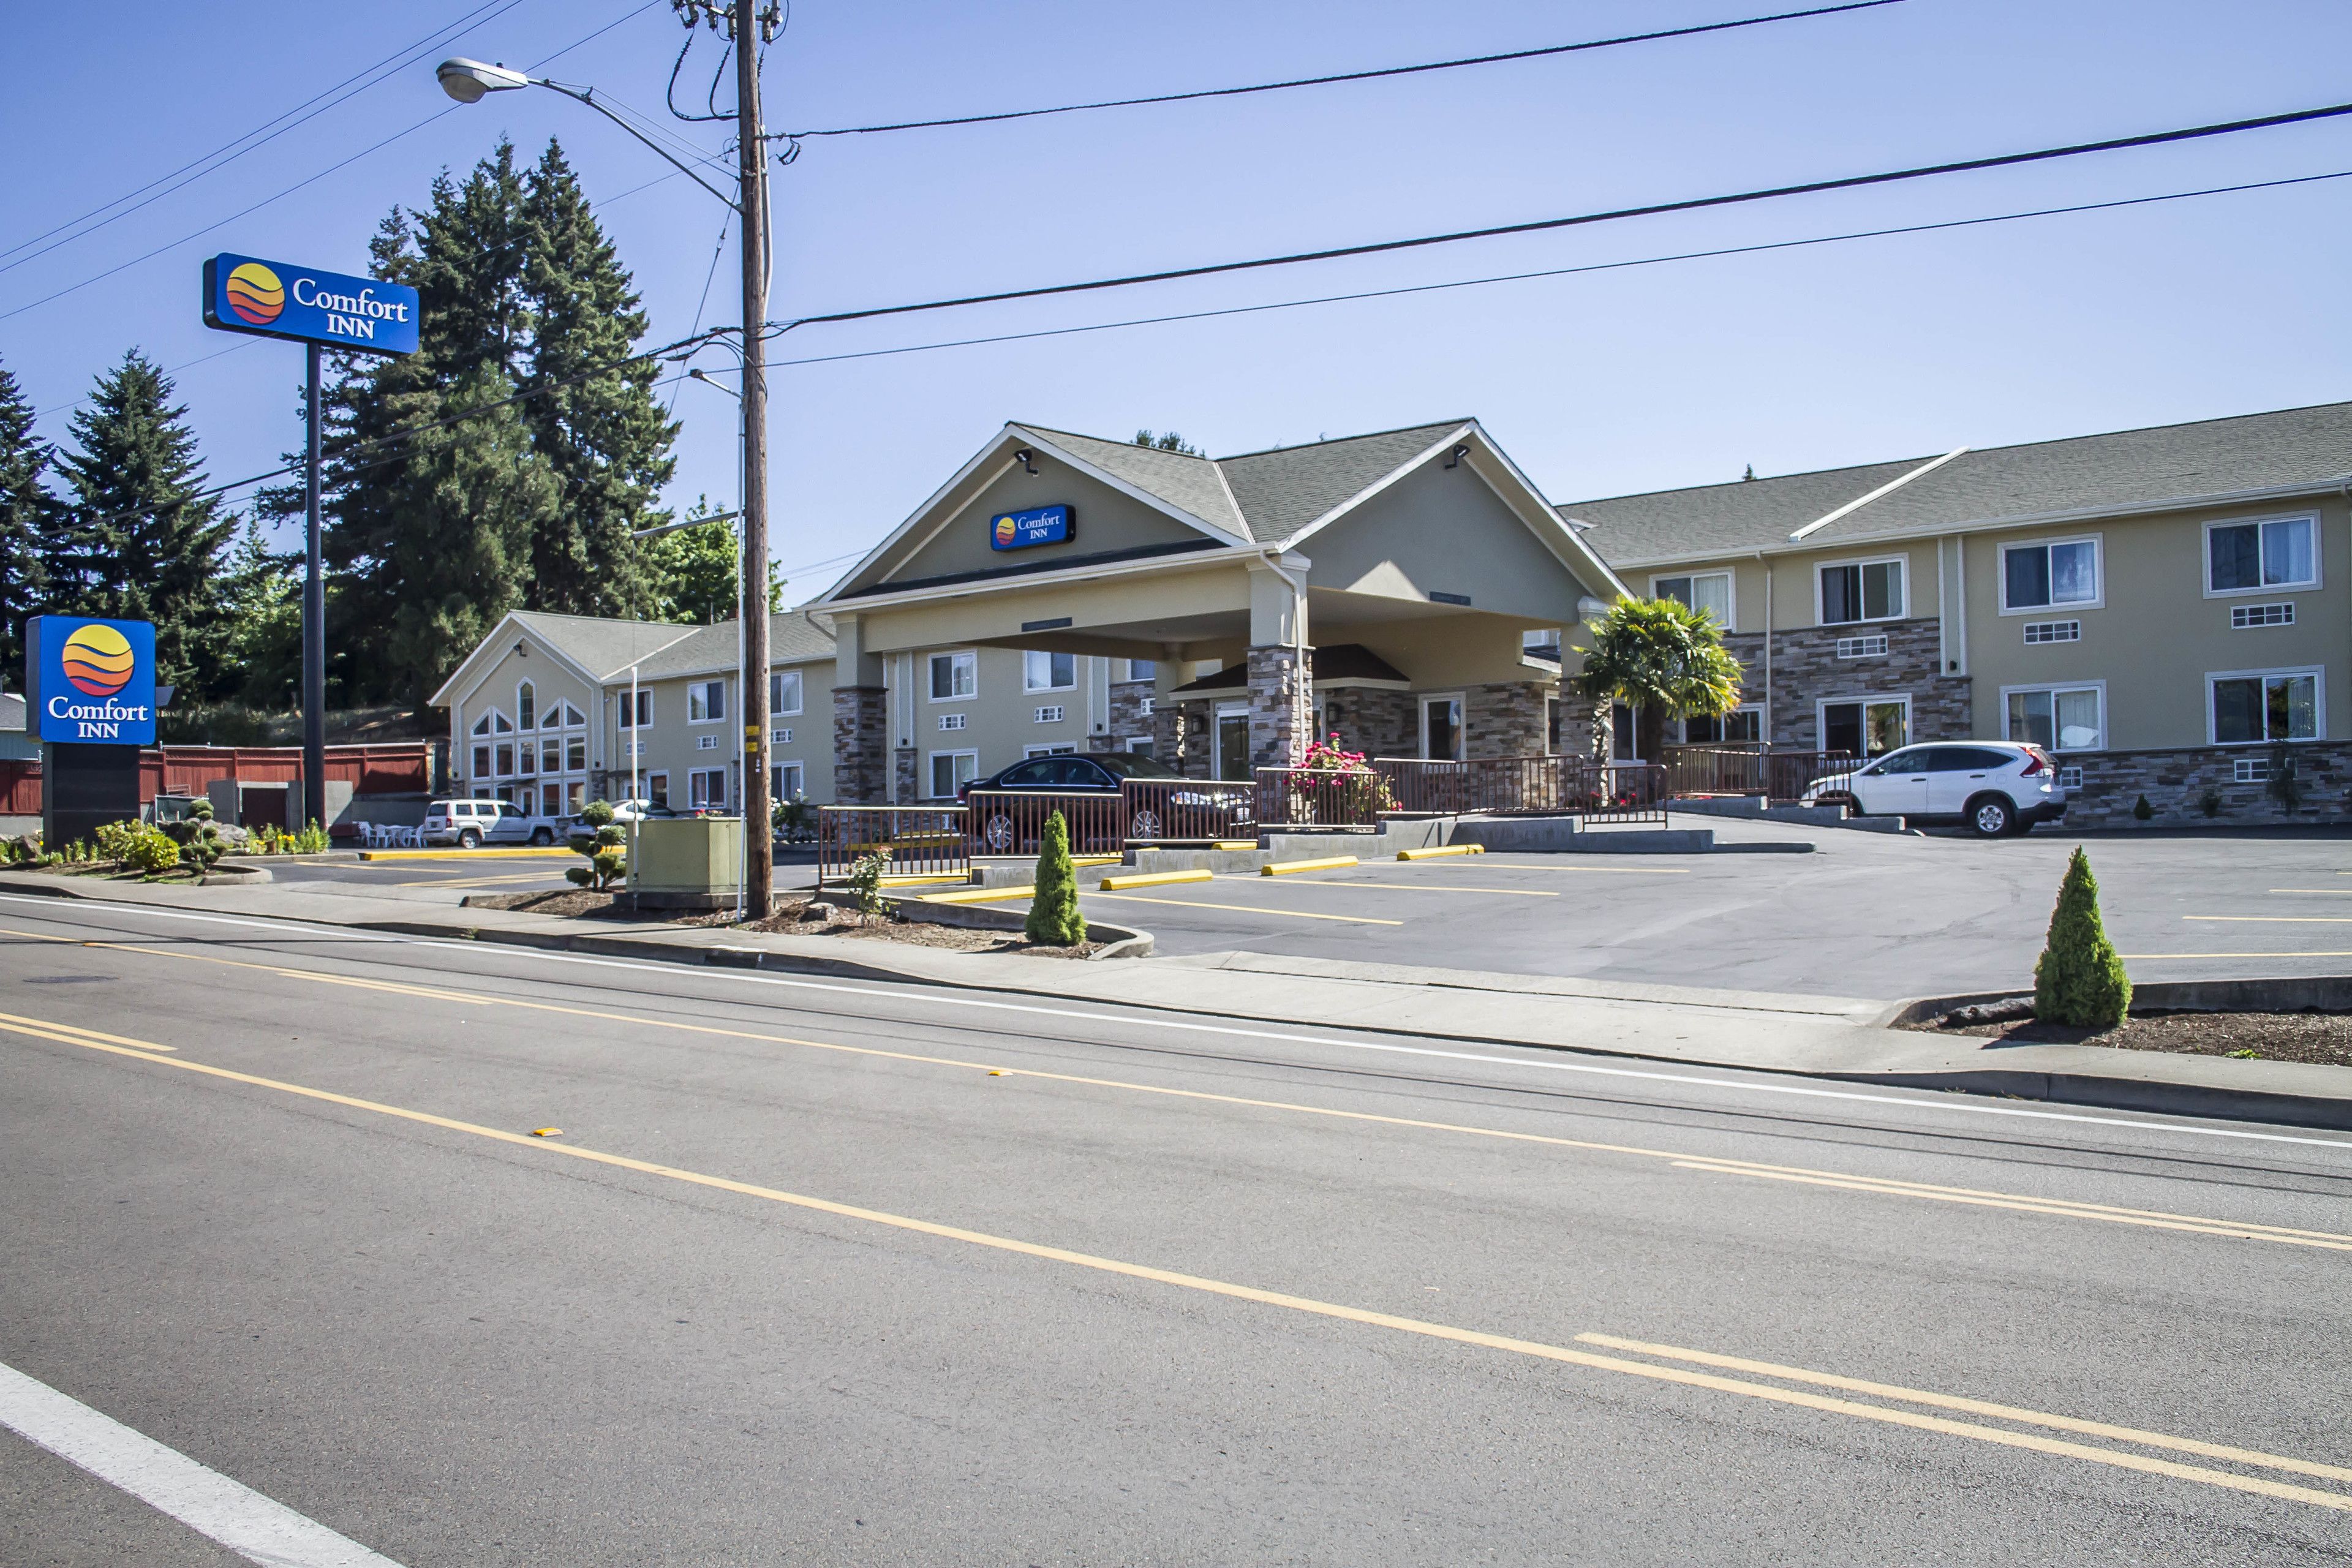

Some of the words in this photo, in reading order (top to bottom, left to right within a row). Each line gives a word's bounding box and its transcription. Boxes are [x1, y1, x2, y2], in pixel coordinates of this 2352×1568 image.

[293, 278, 409, 322] Comfort
[326, 313, 375, 339] INN
[1017, 513, 1060, 530] Comfort
[1030, 528, 1047, 539] INN
[48, 696, 148, 721] Comfort
[78, 722, 119, 738] INN
